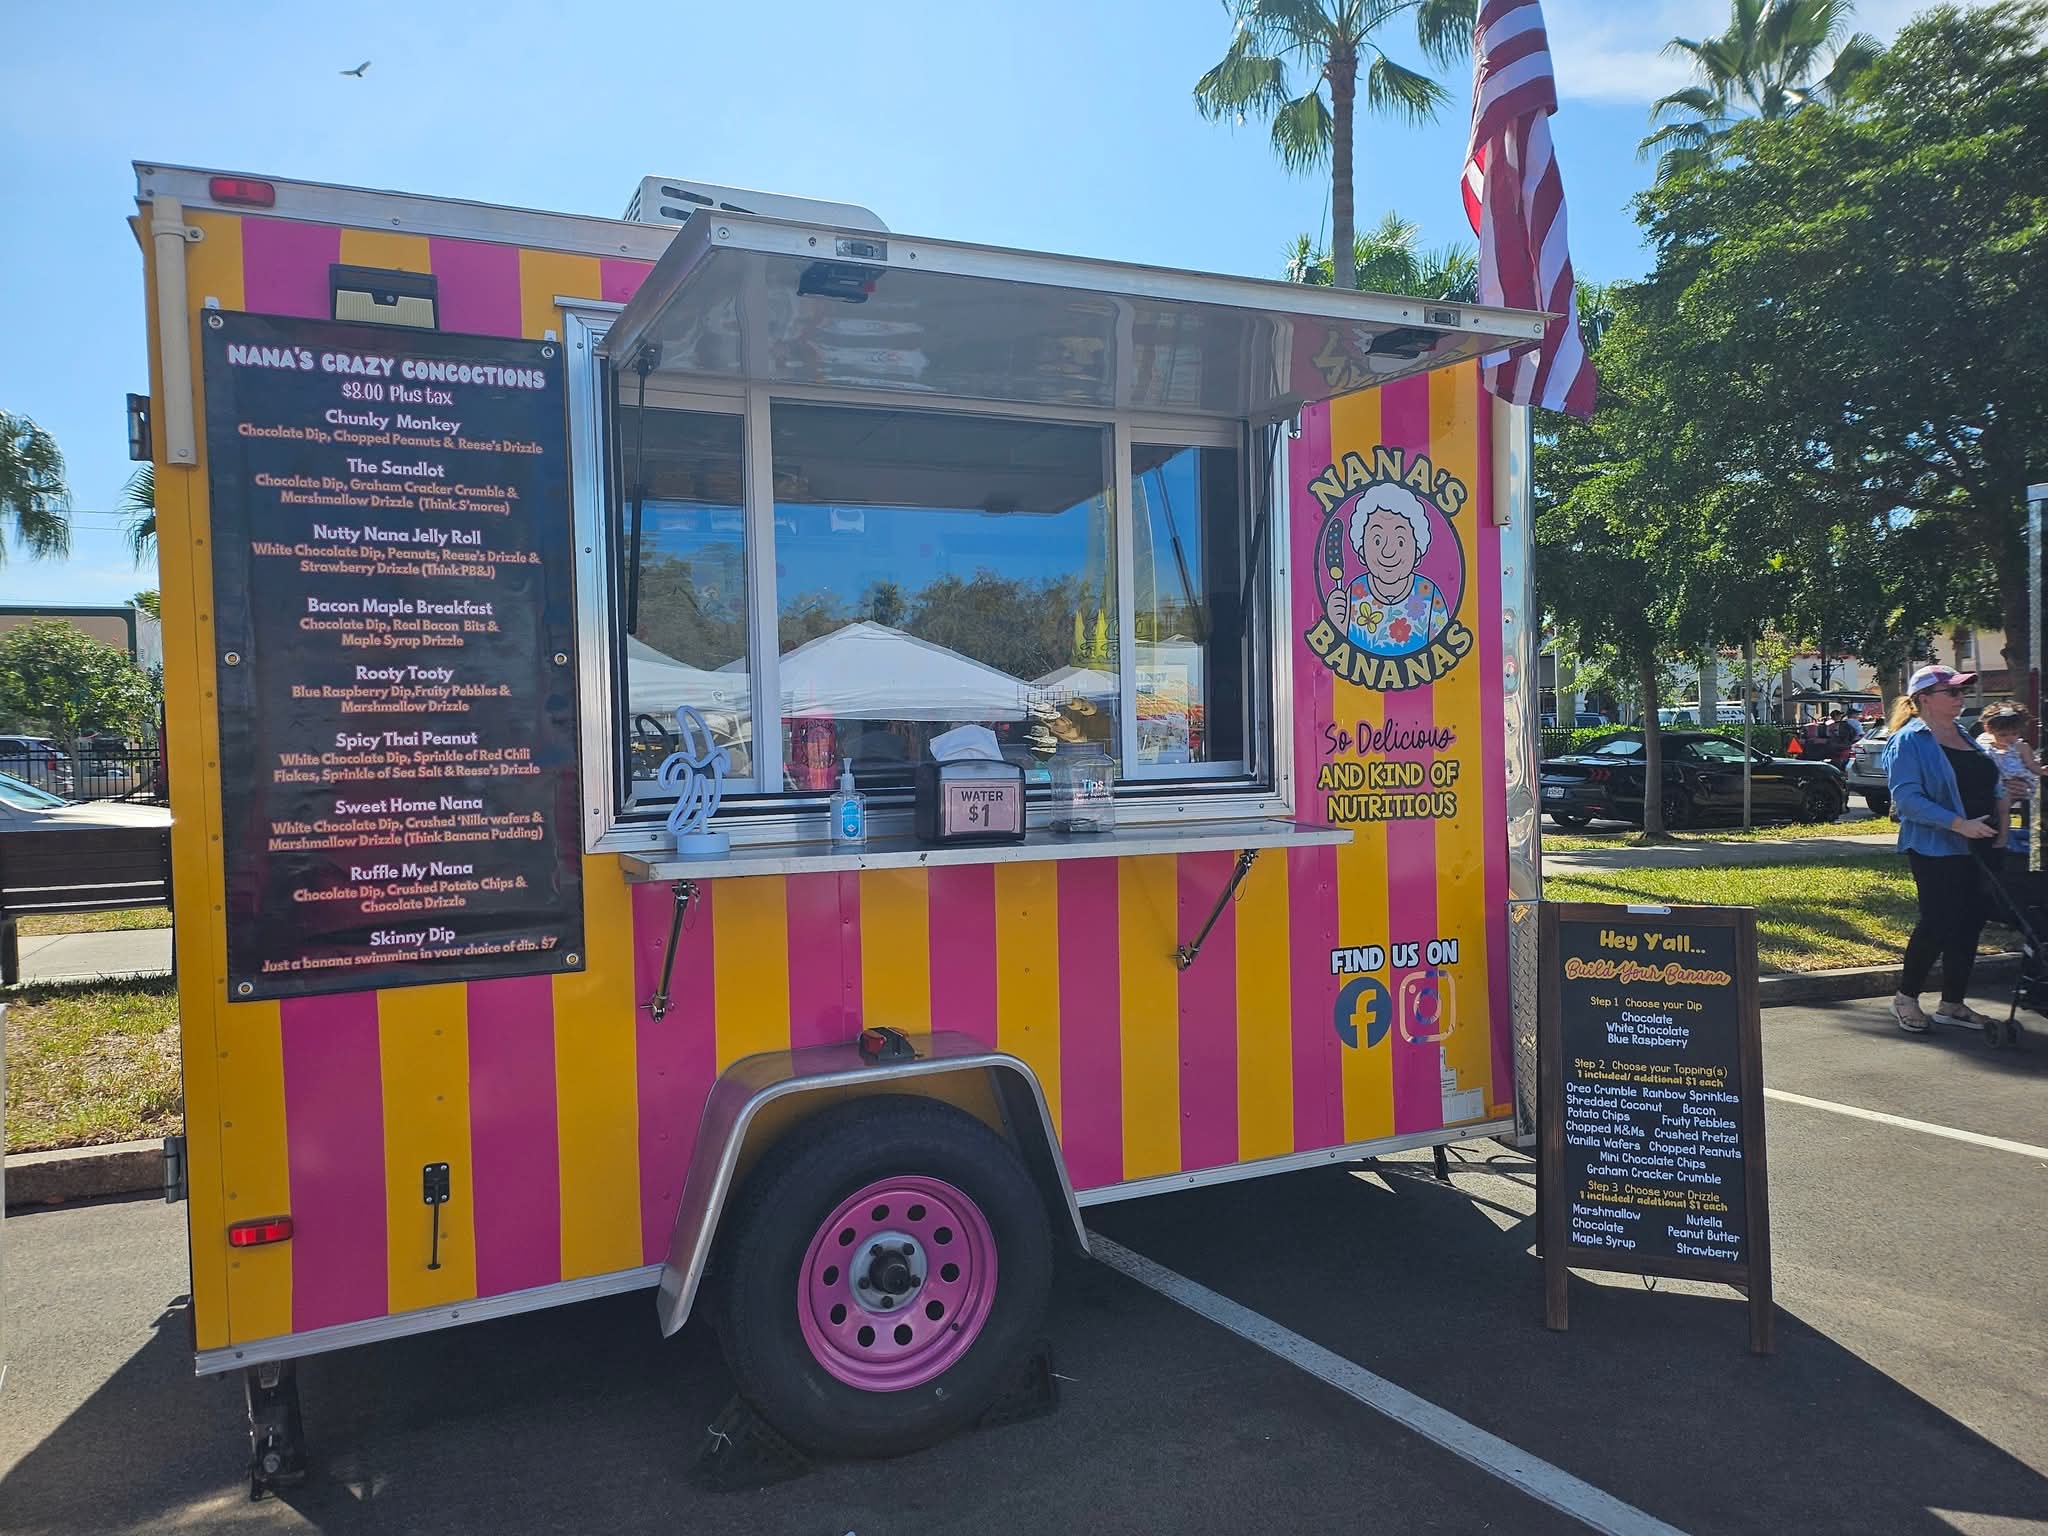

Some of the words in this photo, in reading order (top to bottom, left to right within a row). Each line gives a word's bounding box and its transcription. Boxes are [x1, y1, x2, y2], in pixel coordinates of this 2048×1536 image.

[228, 344, 314, 370] NANA'S
[321, 353, 395, 377] CRAZY
[401, 360, 545, 389] CONCOCTIONS
[342, 382, 383, 400] $8.00
[425, 387, 453, 405] tax
[325, 409, 389, 430] Chunky
[396, 414, 461, 435] Monkey
[238, 423, 303, 438] Chocolate
[305, 428, 332, 443] Dip,
[333, 429, 390, 446] Chopped
[392, 433, 441, 447] Peanuts
[502, 441, 543, 454] Drizzle
[346, 458, 377, 473] The
[381, 461, 445, 477] Sandlot
[255, 473, 320, 488] Chocolate
[321, 477, 348, 492] Dip,
[350, 478, 401, 492] Graham
[403, 481, 452, 494] Cracker
[454, 484, 505, 498] Crumble
[1309, 446, 1468, 518] NANA'S
[280, 490, 368, 506] Marshmallow
[370, 495, 414, 509] Drizzle
[418, 496, 456, 512] (Think
[313, 523, 360, 544] Nutty
[364, 526, 409, 541] Nana
[412, 528, 449, 547] Jelly
[451, 530, 481, 545] Roll
[252, 541, 292, 556] White
[294, 543, 358, 558] Chocolate
[360, 547, 386, 561] Dip,
[387, 547, 440, 562] Peanuts,
[487, 551, 527, 564] Drizzle
[300, 560, 376, 577] Strawberry
[376, 562, 420, 575] Drizzle
[307, 597, 360, 613] Bacon
[362, 598, 414, 617] Maple
[416, 599, 493, 615] Breakfast
[299, 617, 364, 631] Chocolate
[365, 619, 391, 633] Dip,
[393, 619, 421, 632] Real
[422, 619, 459, 632] Bacon
[342, 634, 382, 648] Maple
[383, 635, 421, 648] Syrup
[422, 634, 464, 647] Drizzle
[1305, 617, 1473, 691] BANANAS
[356, 665, 404, 682] Rooty
[408, 666, 454, 682] Tooty
[292, 686, 321, 698] Blue
[322, 686, 389, 700] Raspberry
[452, 686, 497, 697] Pebbles
[341, 700, 426, 713] Marshmallow
[428, 699, 469, 712] Drizzle
[335, 732, 381, 750] Spicy
[383, 732, 419, 746] Thai
[421, 731, 478, 745] Peanut
[1324, 722, 1352, 755] So
[1357, 718, 1456, 755] Delicious
[279, 753, 320, 766] White
[321, 752, 384, 765] Chocolate
[385, 751, 411, 765] Dip,
[413, 750, 464, 765] Sprinkle
[504, 748, 531, 760] Chili
[273, 769, 320, 783] Flakes,
[322, 768, 376, 782] Sprinkle
[500, 763, 540, 775] Drizzle
[1317, 762, 1365, 791] AND
[1369, 762, 1425, 790] KIND
[1429, 760, 1460, 788] OF
[335, 800, 387, 814] Sweet
[389, 798, 437, 812] Home
[440, 796, 483, 810] Nana
[961, 790, 1004, 802] WATER
[968, 803, 990, 827] $1
[1327, 791, 1457, 822] NUTRITIOUS
[271, 822, 312, 835] White
[313, 819, 377, 832] Chocolate
[405, 815, 456, 828] Crushed
[490, 812, 530, 824] wafers
[268, 836, 357, 851] Marshmallow
[359, 834, 402, 846] Drizzle
[404, 831, 443, 847] (Think
[444, 830, 490, 842] Banana
[491, 826, 543, 841] Pudding)
[350, 864, 399, 880] Ruffle
[401, 863, 427, 880] My
[430, 861, 473, 876] Nana
[293, 887, 358, 902] Chocolate
[387, 881, 438, 895] Crushed
[439, 880, 479, 892] Potato
[481, 876, 514, 891] Chips
[361, 898, 423, 912] Chocolate
[424, 895, 466, 909] Drizzle
[370, 931, 426, 947] Skinny
[429, 927, 455, 944] Dip
[1600, 929, 1637, 951] Hey
[262, 960, 290, 972] Just
[302, 956, 352, 969] banana
[354, 949, 418, 965] swimming
[464, 943, 501, 955] choice
[541, 936, 558, 950] $7
[1331, 945, 1385, 974] FIND
[1391, 942, 1420, 968] US
[1426, 939, 1458, 965] ON
[1565, 957, 1616, 980] Build
[1617, 960, 1664, 984] Your
[1664, 963, 1731, 986] Banana
[1625, 998, 1660, 1009] Choose
[1621, 1011, 1673, 1025] Chocolate
[1606, 1022, 1634, 1033] White
[1637, 1024, 1689, 1037] Chocolate
[1631, 1034, 1688, 1048] Raspberry
[1612, 1060, 1647, 1072] Choose
[1674, 1063, 1727, 1079] Topping(s)
[1594, 1084, 1637, 1097] Crumble
[1642, 1087, 1686, 1099] Rainbow
[1689, 1090, 1739, 1103] Sprinkles
[1566, 1094, 1617, 1108] Shredded
[1620, 1099, 1662, 1112] Coconut
[1682, 1103, 1716, 1116] Bacon
[1567, 1107, 1599, 1119] Potato
[1602, 1110, 1630, 1122] Chips
[1662, 1114, 1690, 1128] Fruity
[1693, 1116, 1736, 1128] Pebbles
[1565, 1120, 1611, 1133] Chopped
[1614, 1124, 1645, 1137] M&Ms
[1654, 1128, 1698, 1140] Crushed
[1701, 1131, 1738, 1143] Pretzel
[1566, 1134, 1600, 1146] Vanilla
[1603, 1137, 1640, 1150] Wafers
[1649, 1141, 1696, 1155] Chopped
[1699, 1145, 1742, 1158] Peanuts
[1622, 1153, 1674, 1166] Chocolate
[1677, 1156, 1706, 1170] Chips
[1586, 1163, 1628, 1177] Graham
[1631, 1167, 1674, 1180] Cracker
[1677, 1171, 1722, 1184] Crumble
[1624, 1184, 1660, 1197] Choose
[1687, 1190, 1720, 1201] Drizzle
[1572, 1203, 1641, 1220] Marshmallow
[1572, 1217, 1624, 1233] Chocolate
[1686, 1214, 1722, 1228] Nutella
[1572, 1232, 1602, 1246] Maple
[1605, 1235, 1636, 1250] Syrup
[1667, 1226, 1703, 1239] Peanut
[1707, 1229, 1740, 1243] Butter
[1676, 1242, 1739, 1261] Strawberry
